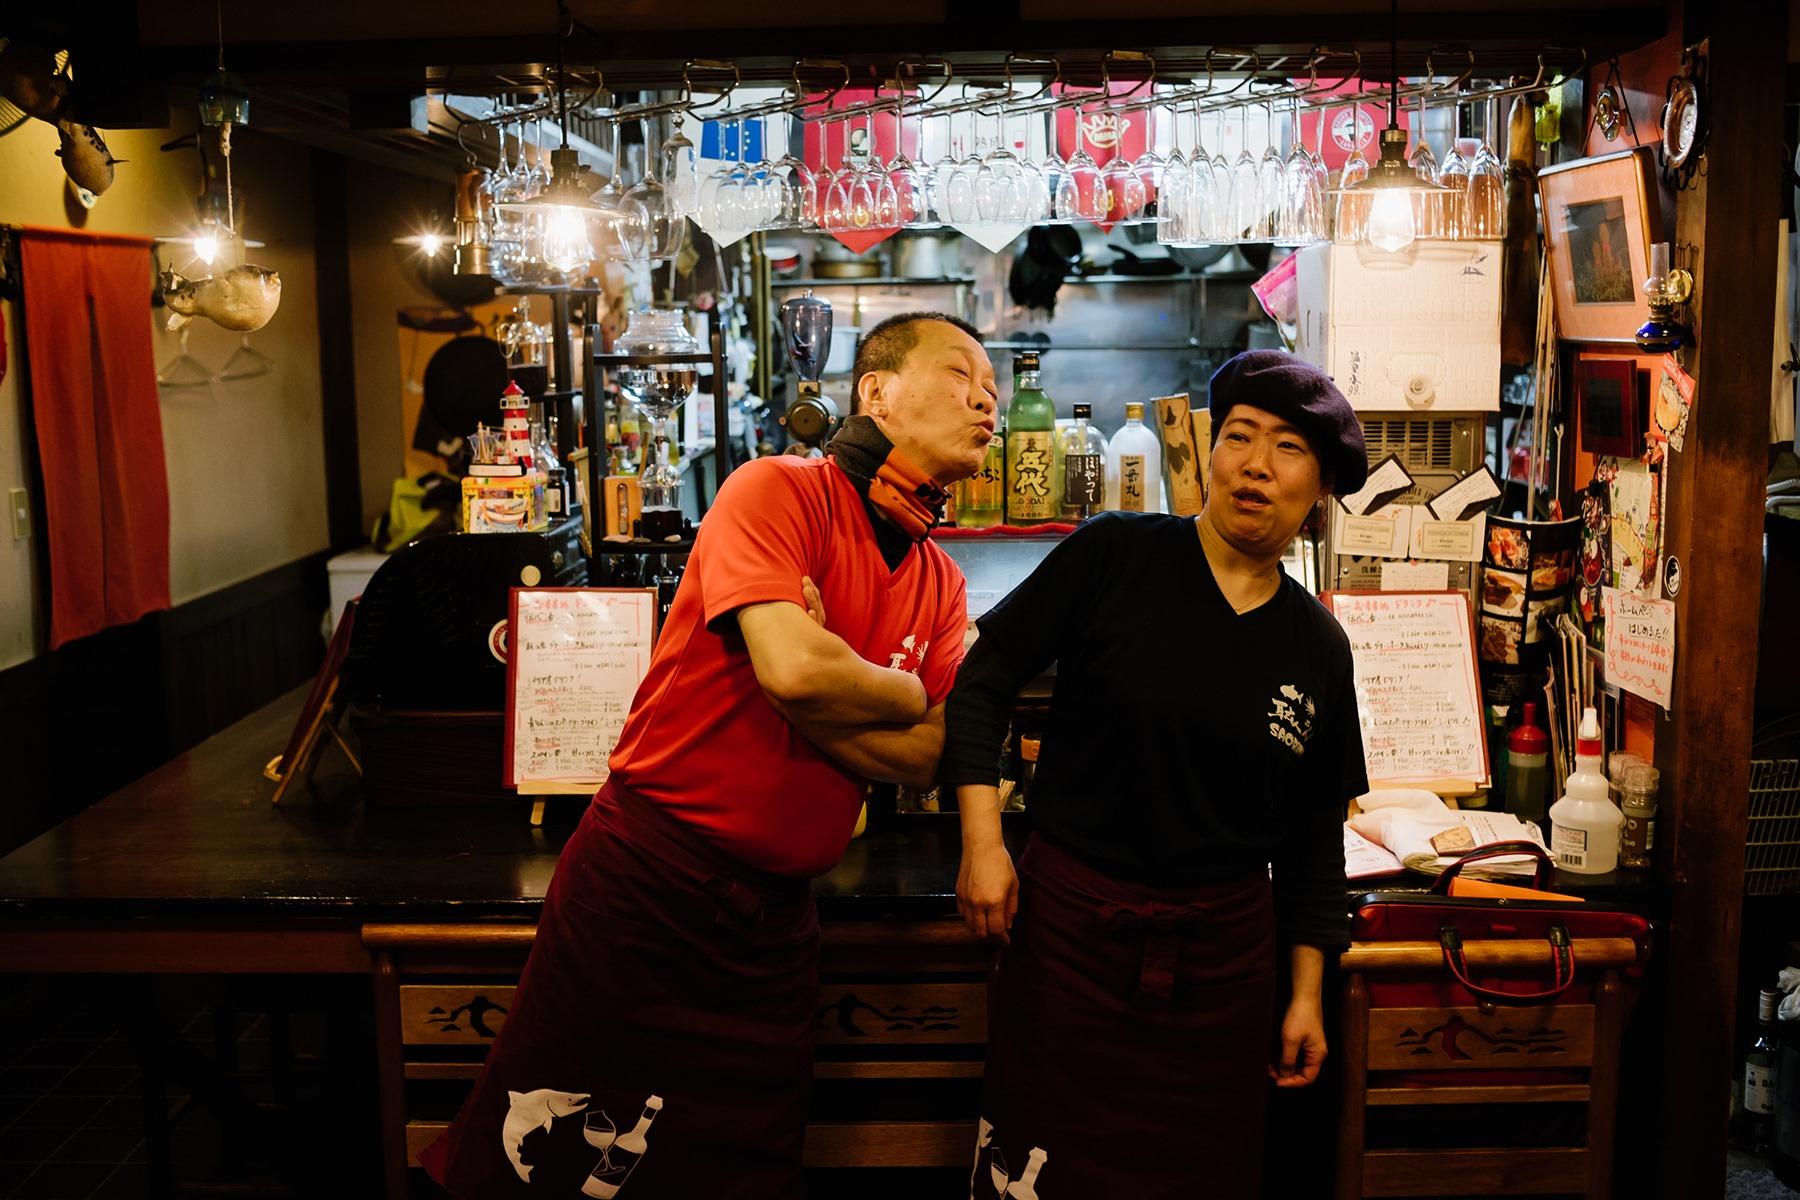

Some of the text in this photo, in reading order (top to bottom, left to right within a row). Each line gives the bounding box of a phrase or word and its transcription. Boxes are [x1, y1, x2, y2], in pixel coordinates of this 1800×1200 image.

[972, 466, 1000, 484] いちこ
[1014, 450, 1049, 496] 五代
[1084, 456, 1096, 503] ほやって
